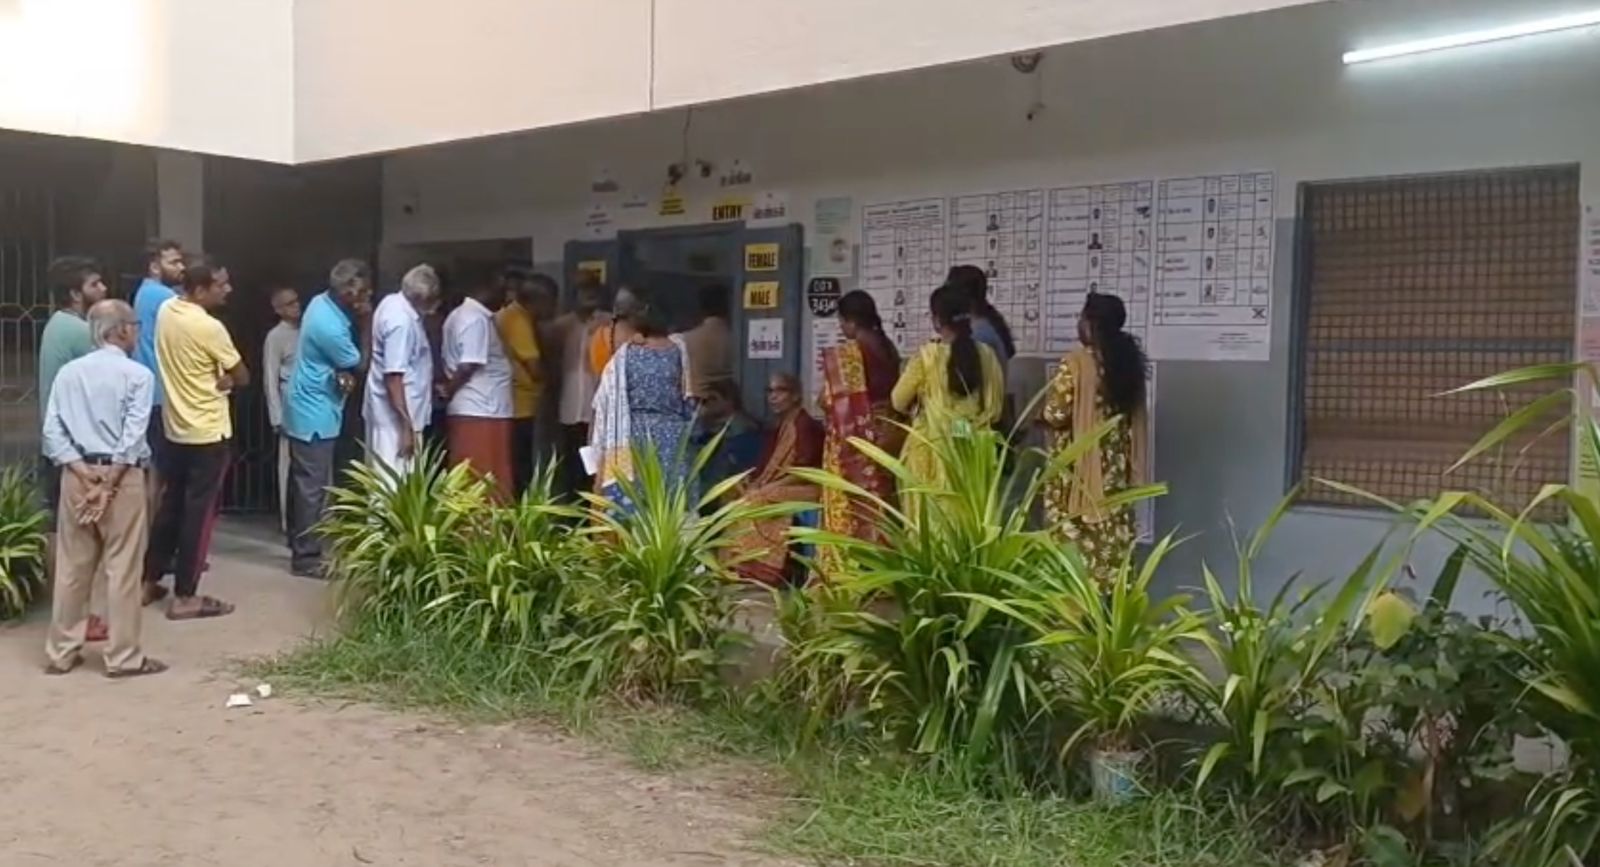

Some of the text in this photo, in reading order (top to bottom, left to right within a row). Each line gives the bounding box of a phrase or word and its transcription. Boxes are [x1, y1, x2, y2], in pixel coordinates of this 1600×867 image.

[712, 204, 742, 221] ENTRY
[748, 252, 776, 268] FEMALE
[750, 289, 771, 306] MALE
